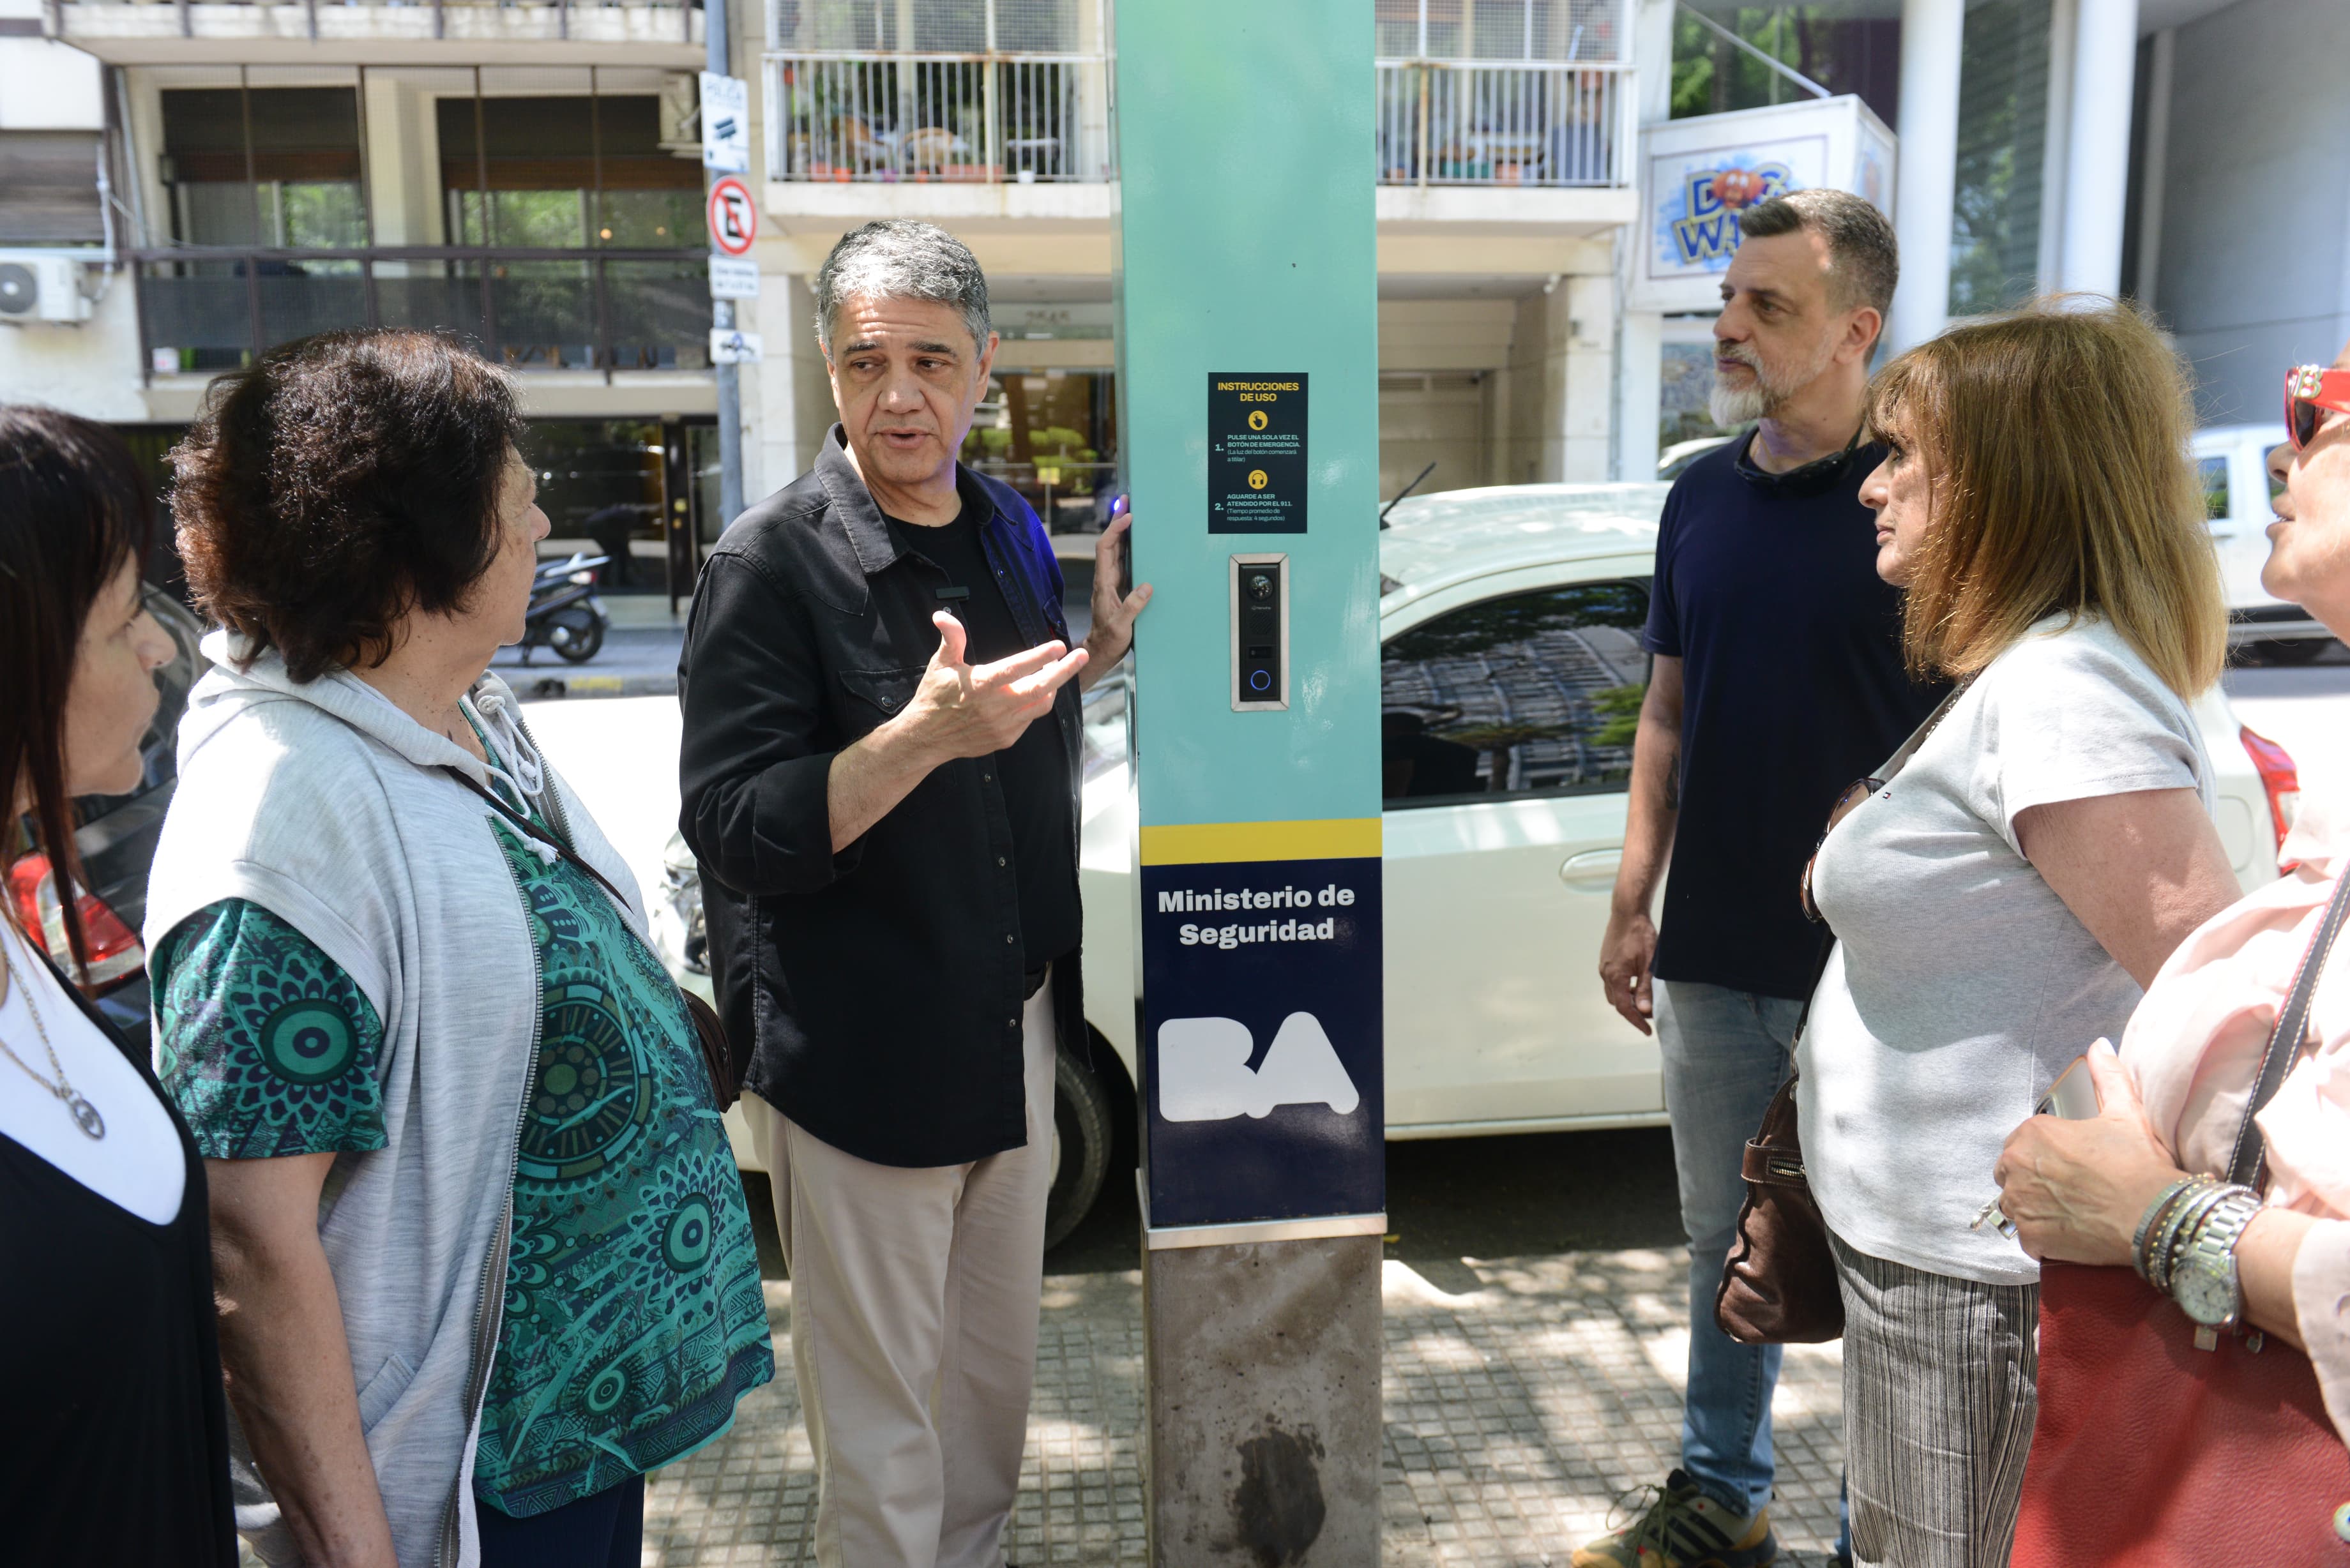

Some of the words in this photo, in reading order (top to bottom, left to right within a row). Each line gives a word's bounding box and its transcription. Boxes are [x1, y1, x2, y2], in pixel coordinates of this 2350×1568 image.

[1672, 207, 1747, 264] WA
[1218, 382, 1300, 391] INSTRUCCIONES
[1239, 393, 1254, 402] DE
[1255, 393, 1277, 402] USO
[1158, 886, 1312, 912] Ministerio
[1318, 884, 1355, 906] de
[1179, 918, 1334, 949] Seguridad
[1158, 1011, 1359, 1122] BA
